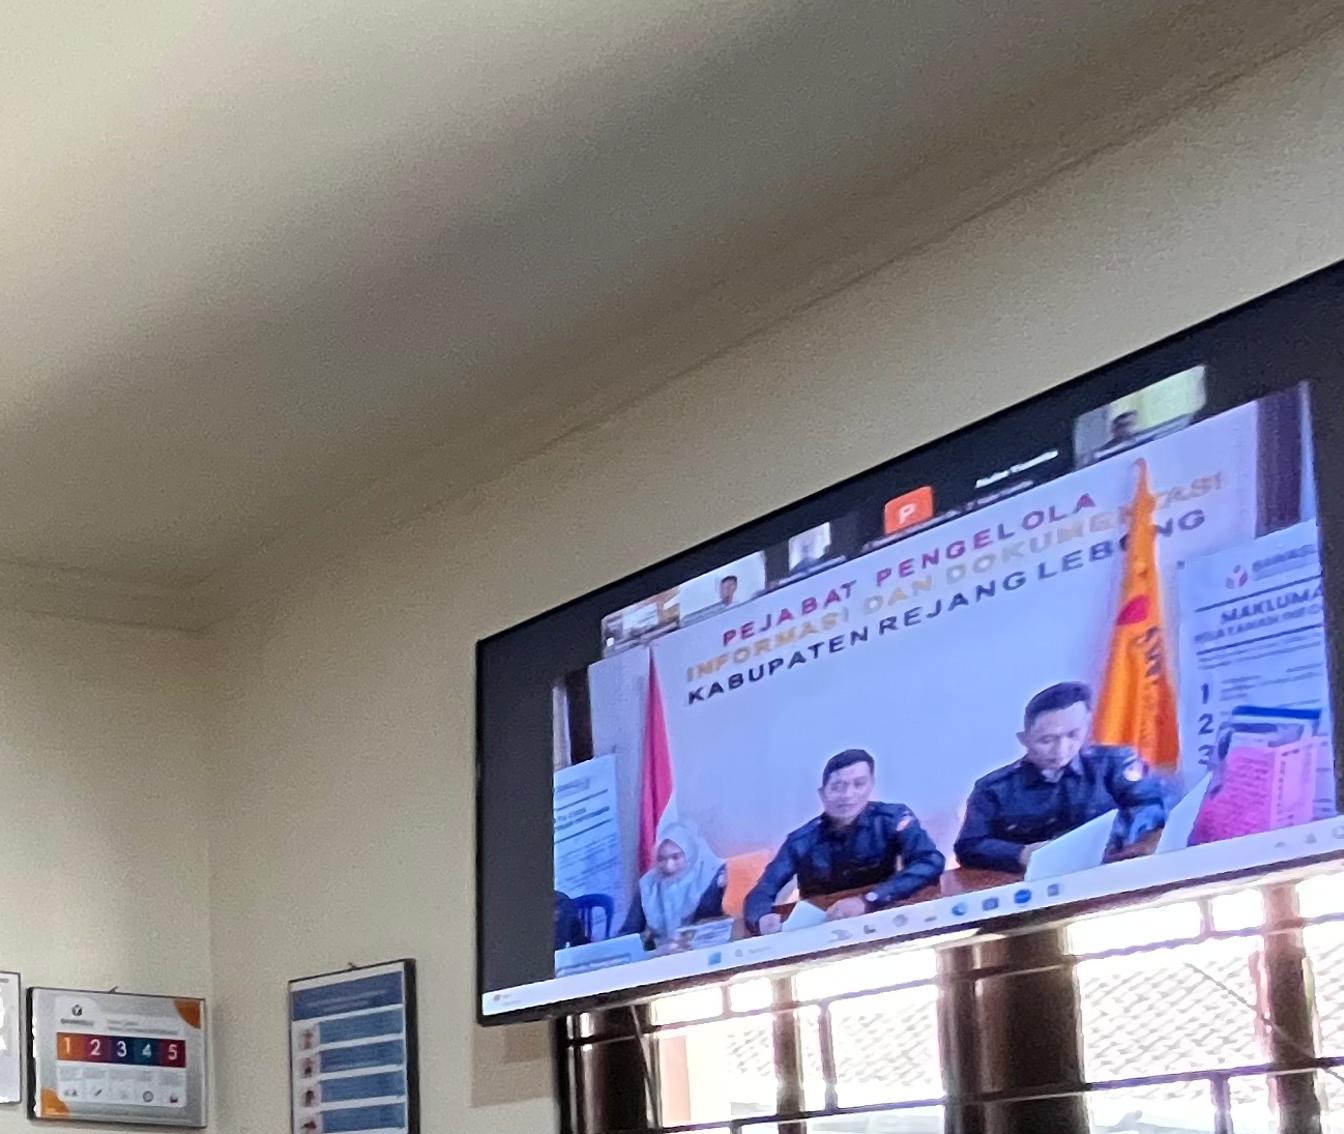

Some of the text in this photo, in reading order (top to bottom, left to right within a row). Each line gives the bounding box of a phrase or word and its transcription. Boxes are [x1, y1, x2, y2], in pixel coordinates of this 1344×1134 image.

[897, 502, 918, 524] P
[722, 579, 858, 647] PEJABAT
[875, 493, 1096, 588] PENGELOLA
[686, 606, 849, 683] INFORMASI
[863, 574, 933, 616] DAN
[687, 625, 868, 705] KABUPATEN
[878, 570, 1027, 636] REJANG
[1198, 713, 1214, 736] 2
[63, 1036, 178, 1061] 1 2 3 4 5
